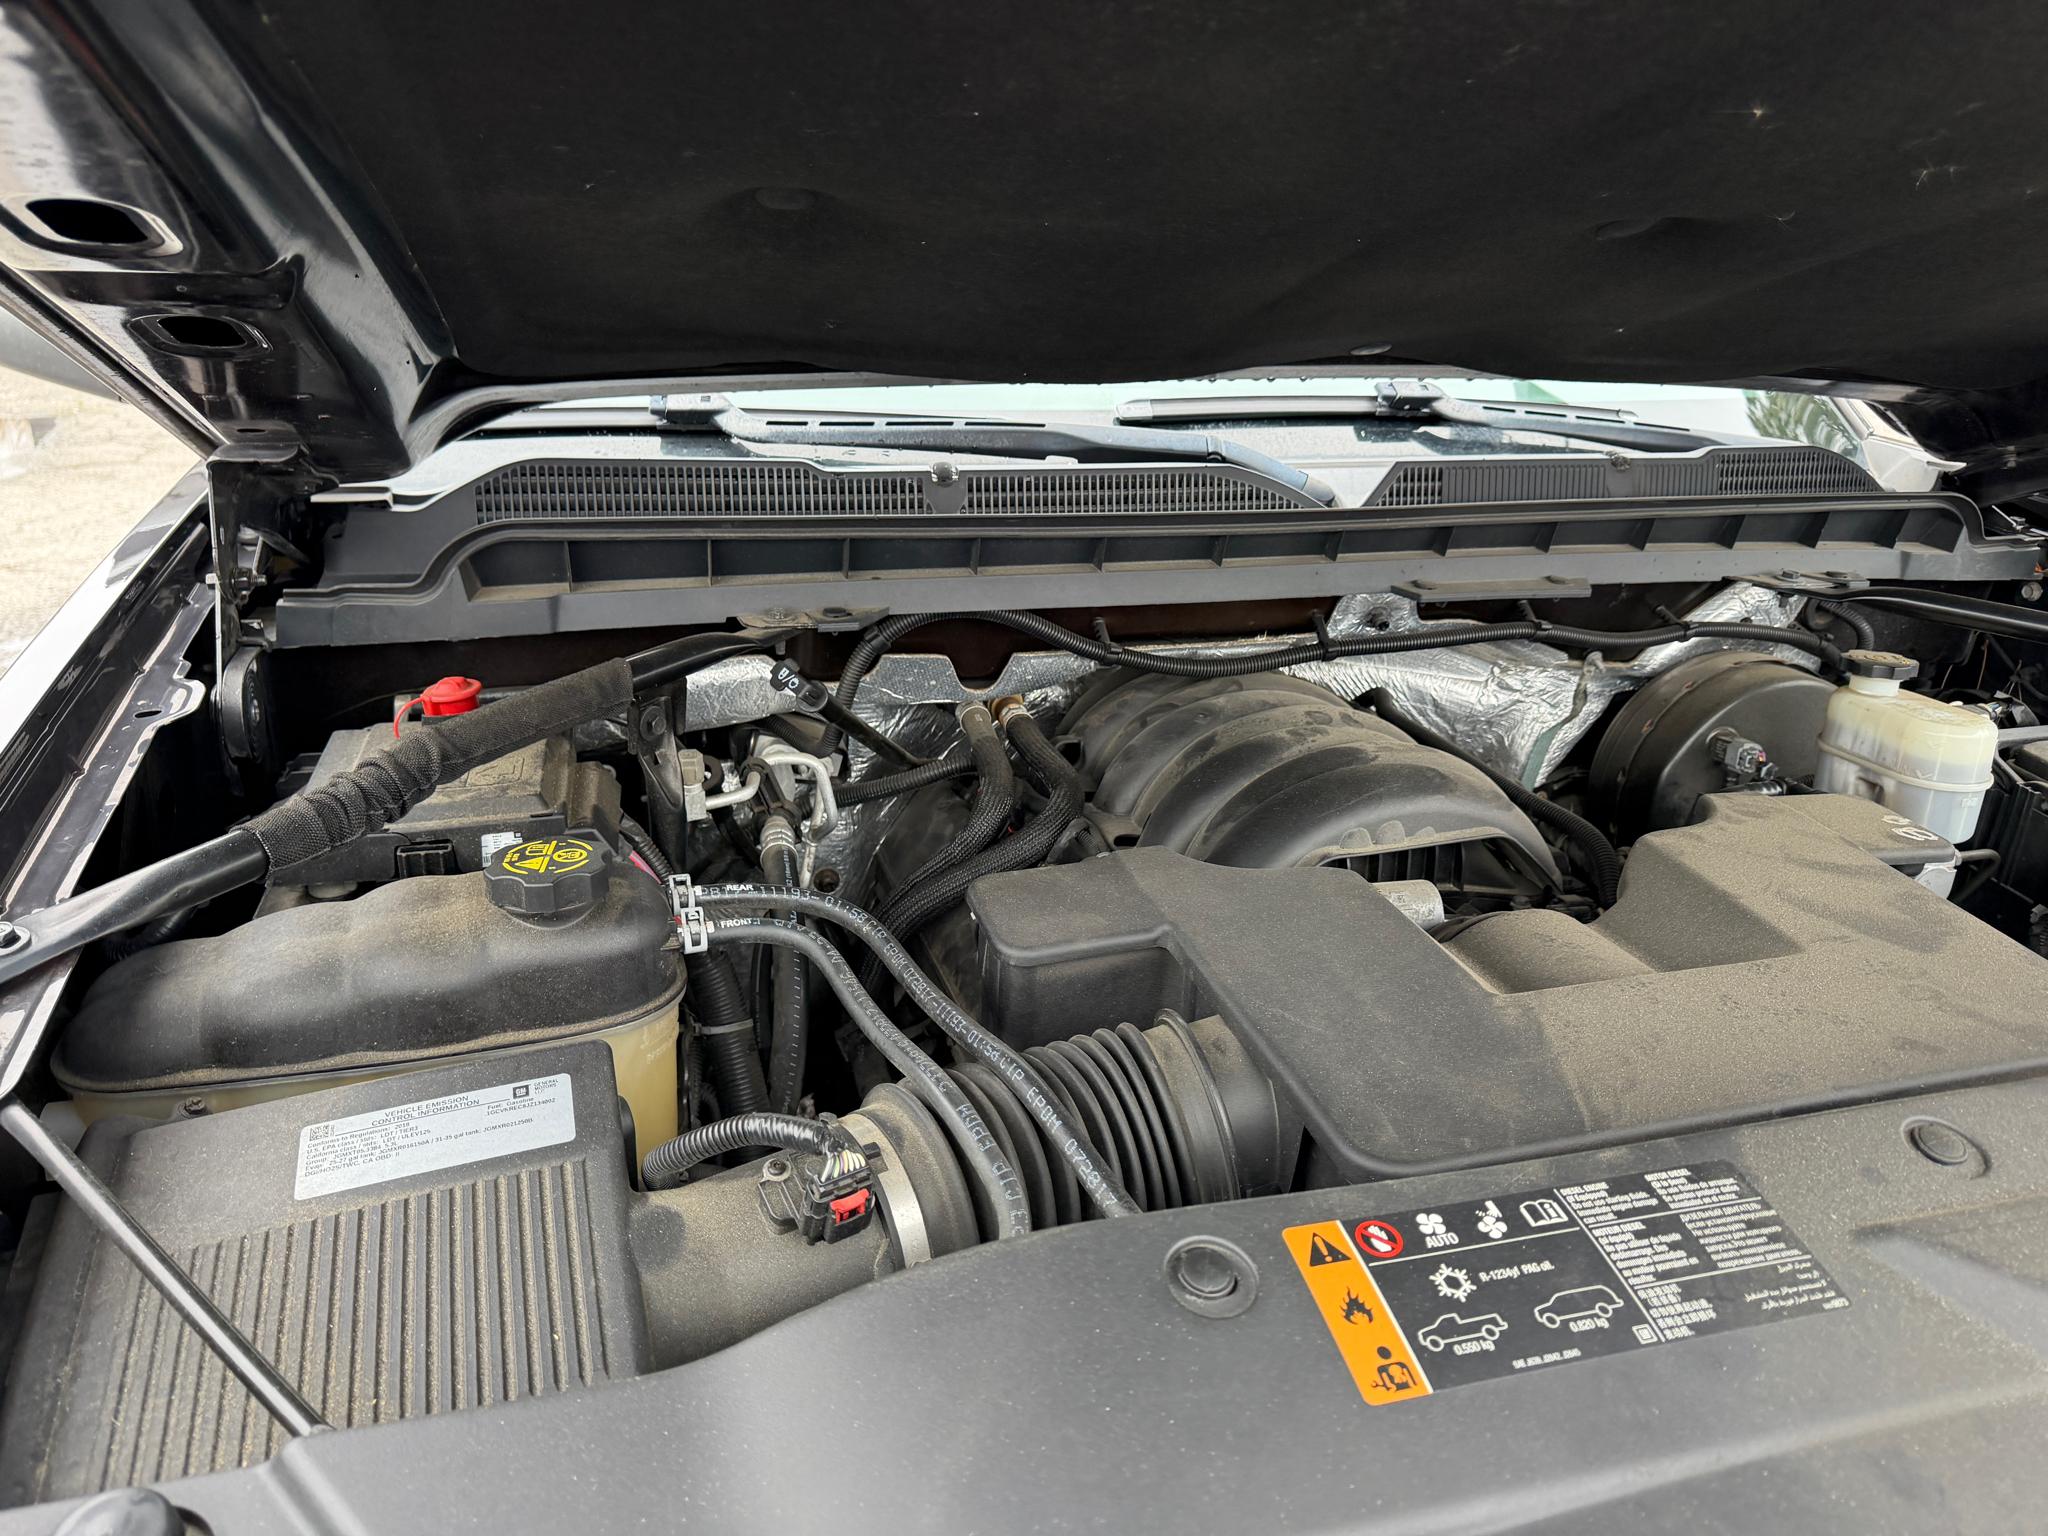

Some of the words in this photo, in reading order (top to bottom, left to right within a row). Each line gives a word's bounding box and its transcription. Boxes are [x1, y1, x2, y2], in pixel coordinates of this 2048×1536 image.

[721, 918, 753, 929] FRONT
[903, 967, 936, 1002] 072817
[384, 1106, 423, 1118] VEHICLE
[425, 1096, 468, 1109] EMISSION
[506, 1097, 534, 1106] Gasoline
[371, 1114, 415, 1126] CONTROL
[418, 1100, 479, 1116] INFORMATION
[307, 1138, 338, 1148] Conforms
[349, 1128, 390, 1140] Regulations:
[306, 1149, 338, 1159] California
[348, 1155, 360, 1163] gal
[453, 1132, 463, 1140] gal
[1425, 1232, 1459, 1248] AUTO
[1479, 1266, 1520, 1282] R-1234yf
[1521, 1262, 1541, 1274] PAG
[1540, 1260, 1555, 1271] oil.
[1569, 1318, 1595, 1332] 0.820
[1593, 1315, 1609, 1328] kg
[1479, 1338, 1495, 1351] kg
